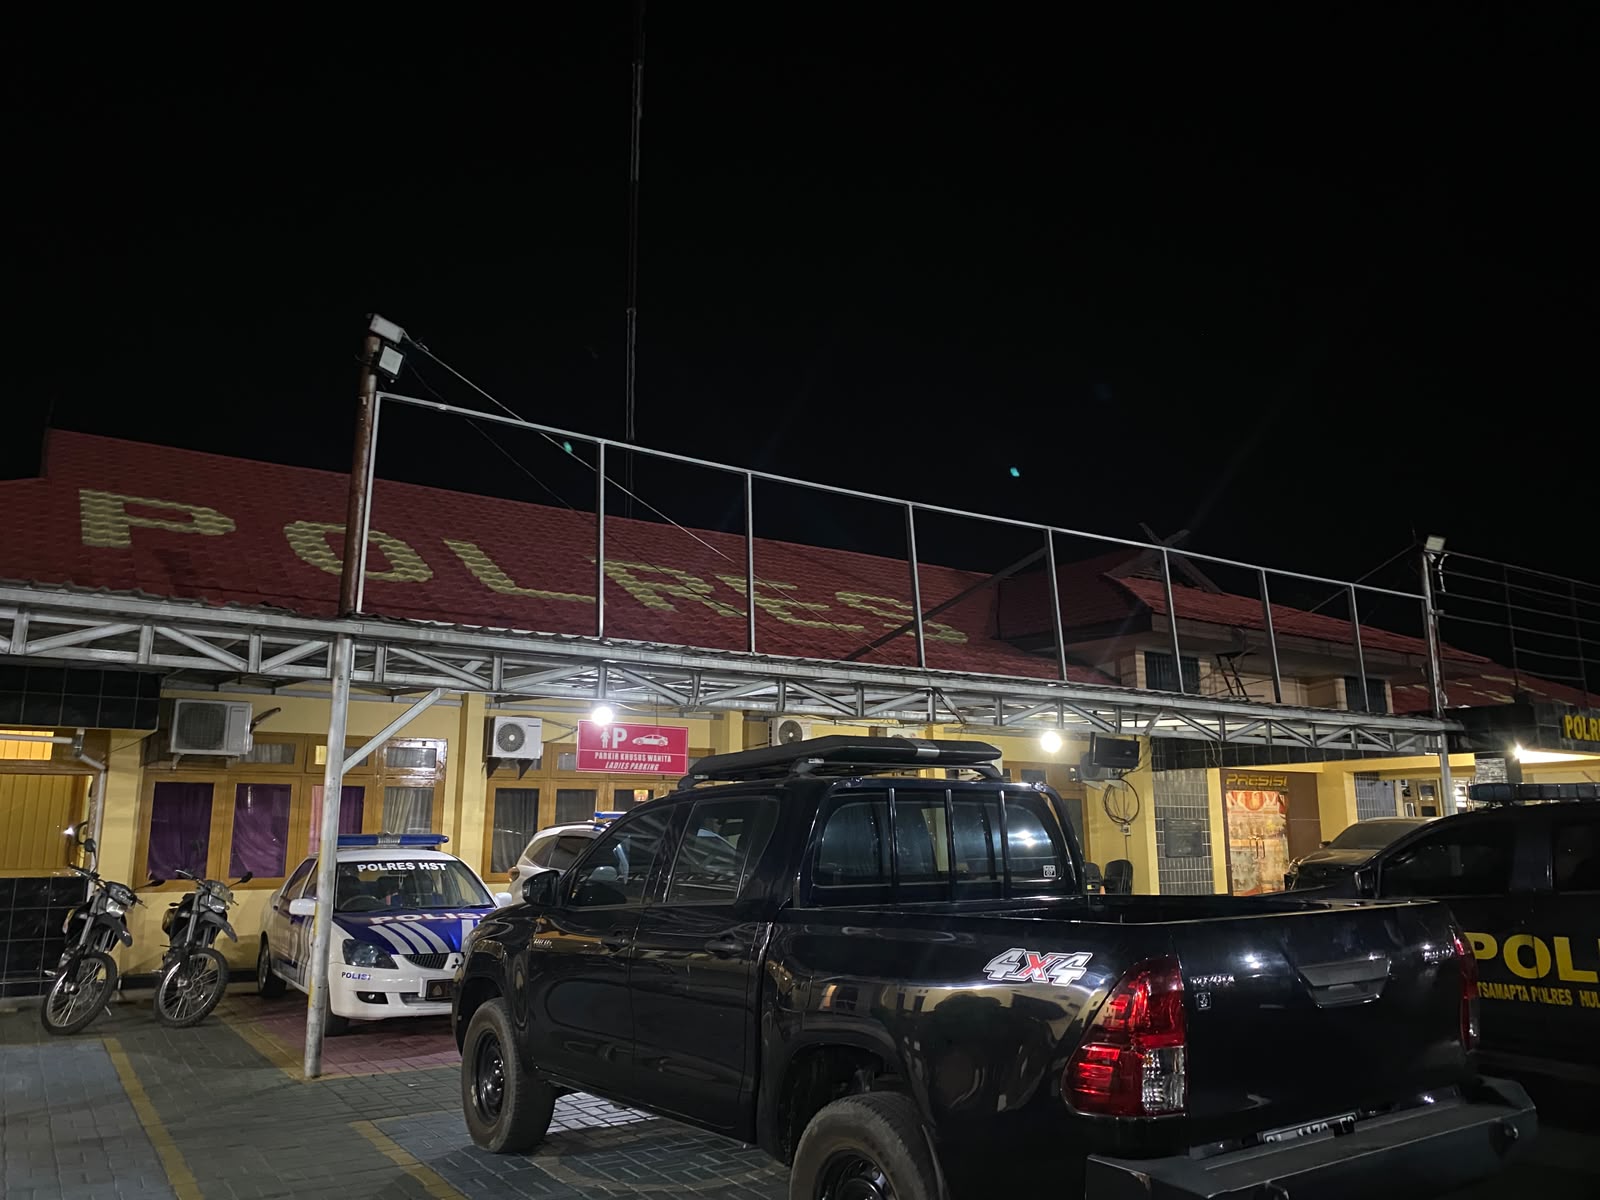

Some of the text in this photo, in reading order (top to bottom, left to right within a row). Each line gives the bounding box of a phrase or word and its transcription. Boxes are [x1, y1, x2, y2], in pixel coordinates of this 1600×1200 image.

[79, 487, 968, 645] POLRES
[612, 727, 628, 749] P
[594, 751, 619, 761] PARKIR
[647, 754, 672, 763] WANITA
[605, 761, 660, 771] LADIES PARKING
[357, 862, 447, 873] POLRES HST
[1464, 932, 1600, 983] POL
